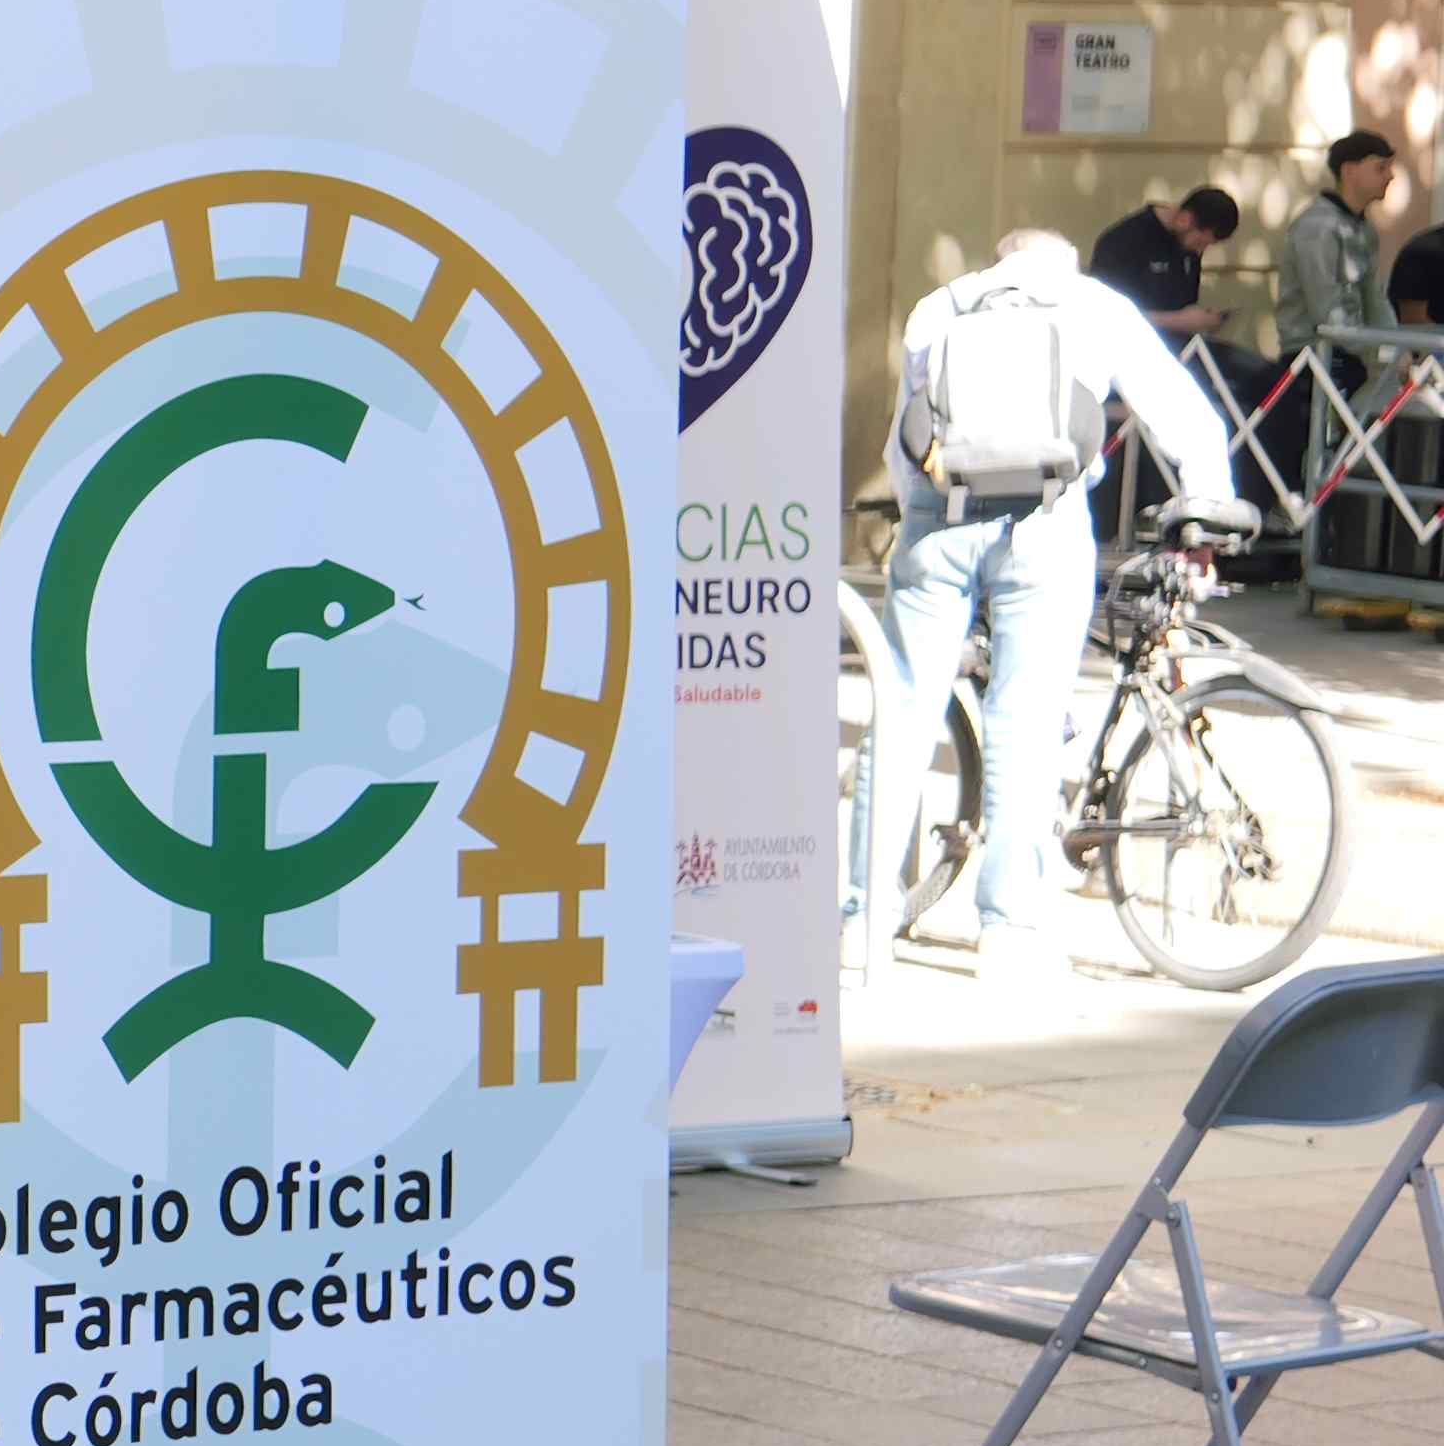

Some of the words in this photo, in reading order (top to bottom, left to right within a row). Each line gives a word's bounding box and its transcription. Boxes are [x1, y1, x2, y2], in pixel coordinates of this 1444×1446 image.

[1075, 33, 1116, 50] GRAN
[1075, 54, 1130, 70] TEATRO
[676, 501, 810, 562] CIAS
[675, 577, 811, 615] NEURO
[677, 632, 767, 669] IDAS
[724, 835, 817, 855] AYUNTAMIENTO
[219, 1149, 453, 1237] Oficial
[34, 1246, 576, 1354] Farmacéuticos
